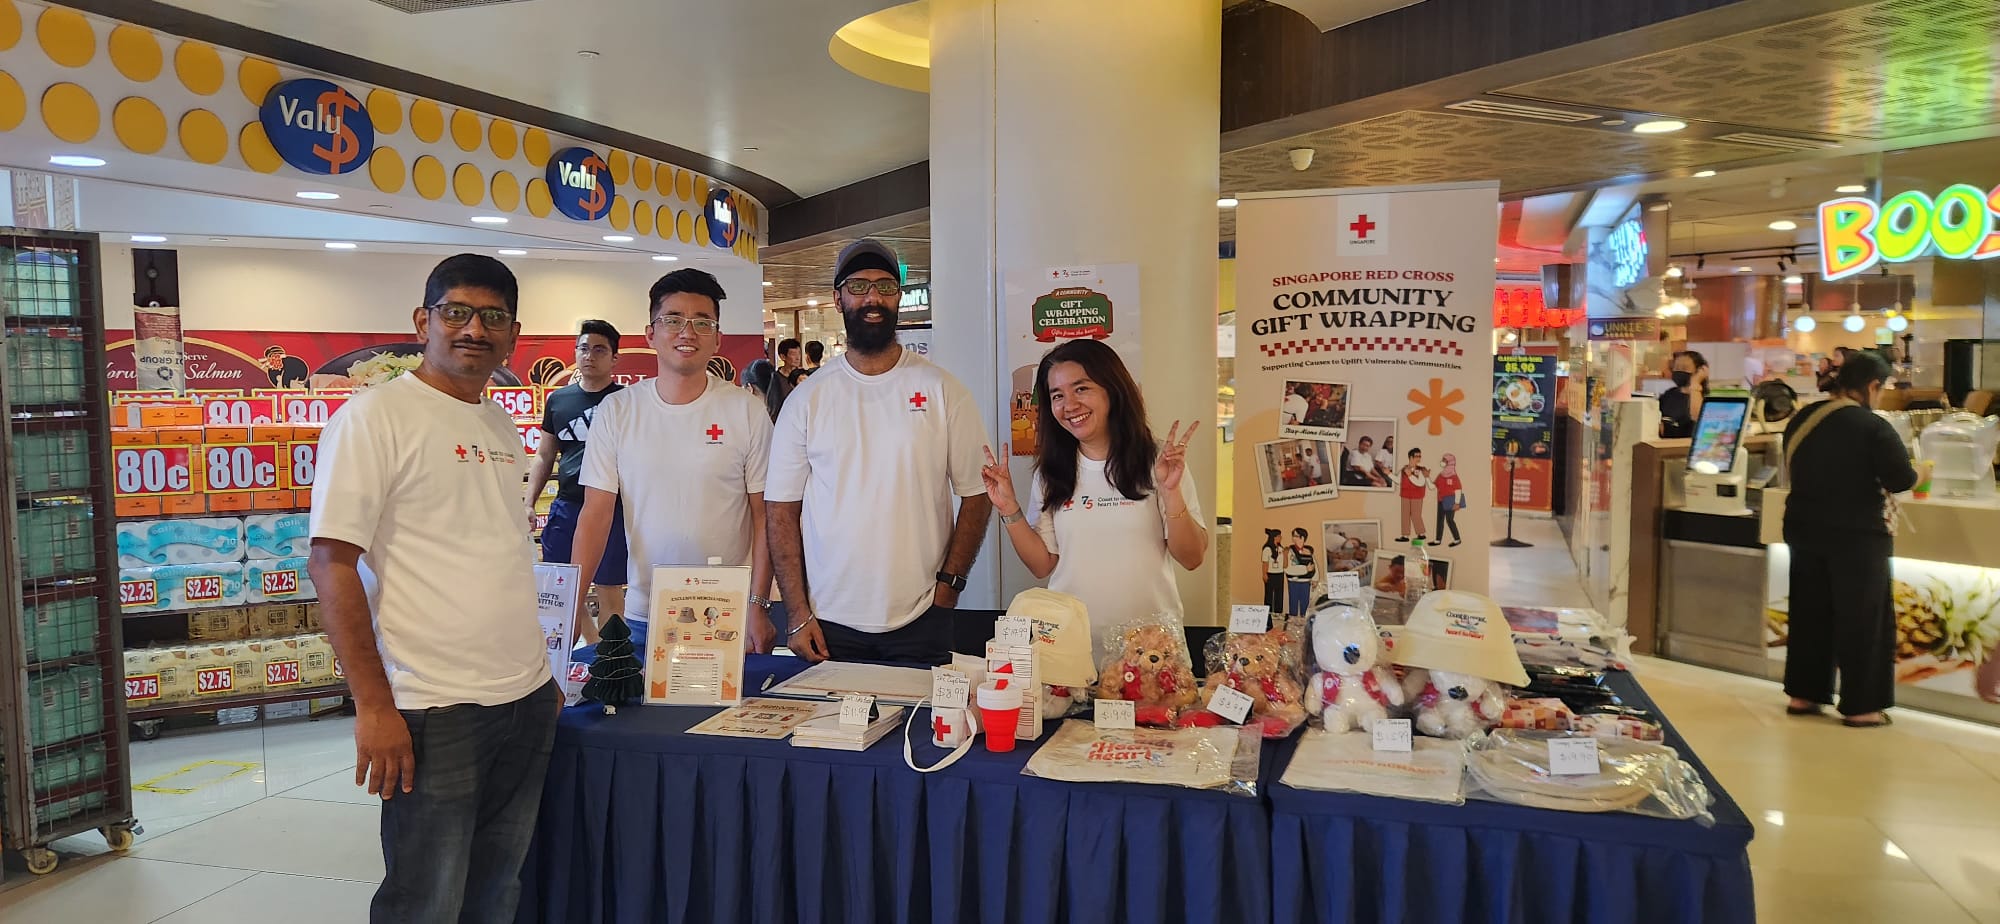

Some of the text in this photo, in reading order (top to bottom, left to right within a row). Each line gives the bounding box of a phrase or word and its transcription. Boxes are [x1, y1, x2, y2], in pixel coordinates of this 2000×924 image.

[1272, 270, 1455, 288] SINGAPORE RED CROSS
[1060, 300, 1084, 309] GIFT
[1273, 288, 1454, 311] COMMUNITY
[1038, 316, 1106, 327] CELEBRATION
[1045, 307, 1099, 318] WRAPPING
[1251, 310, 1477, 336] GIFT WRAPPING
[139, 356, 172, 365] GROUP
[182, 351, 209, 362] Serve
[1261, 360, 1304, 372] Supporting
[1304, 359, 1331, 367] Causes
[1340, 357, 1363, 366] Uplift
[1364, 357, 1408, 366] Vulnerable
[1408, 359, 1463, 370] Communities
[184, 362, 243, 380] Salmon
[1312, 488, 1334, 497] Family
[119, 582, 155, 601] $2.25
[186, 578, 220, 600] $2.25
[263, 572, 297, 594] $2.25
[198, 671, 232, 692] $2.75
[266, 662, 299, 684] $2.75
[124, 678, 158, 698] $2.75
